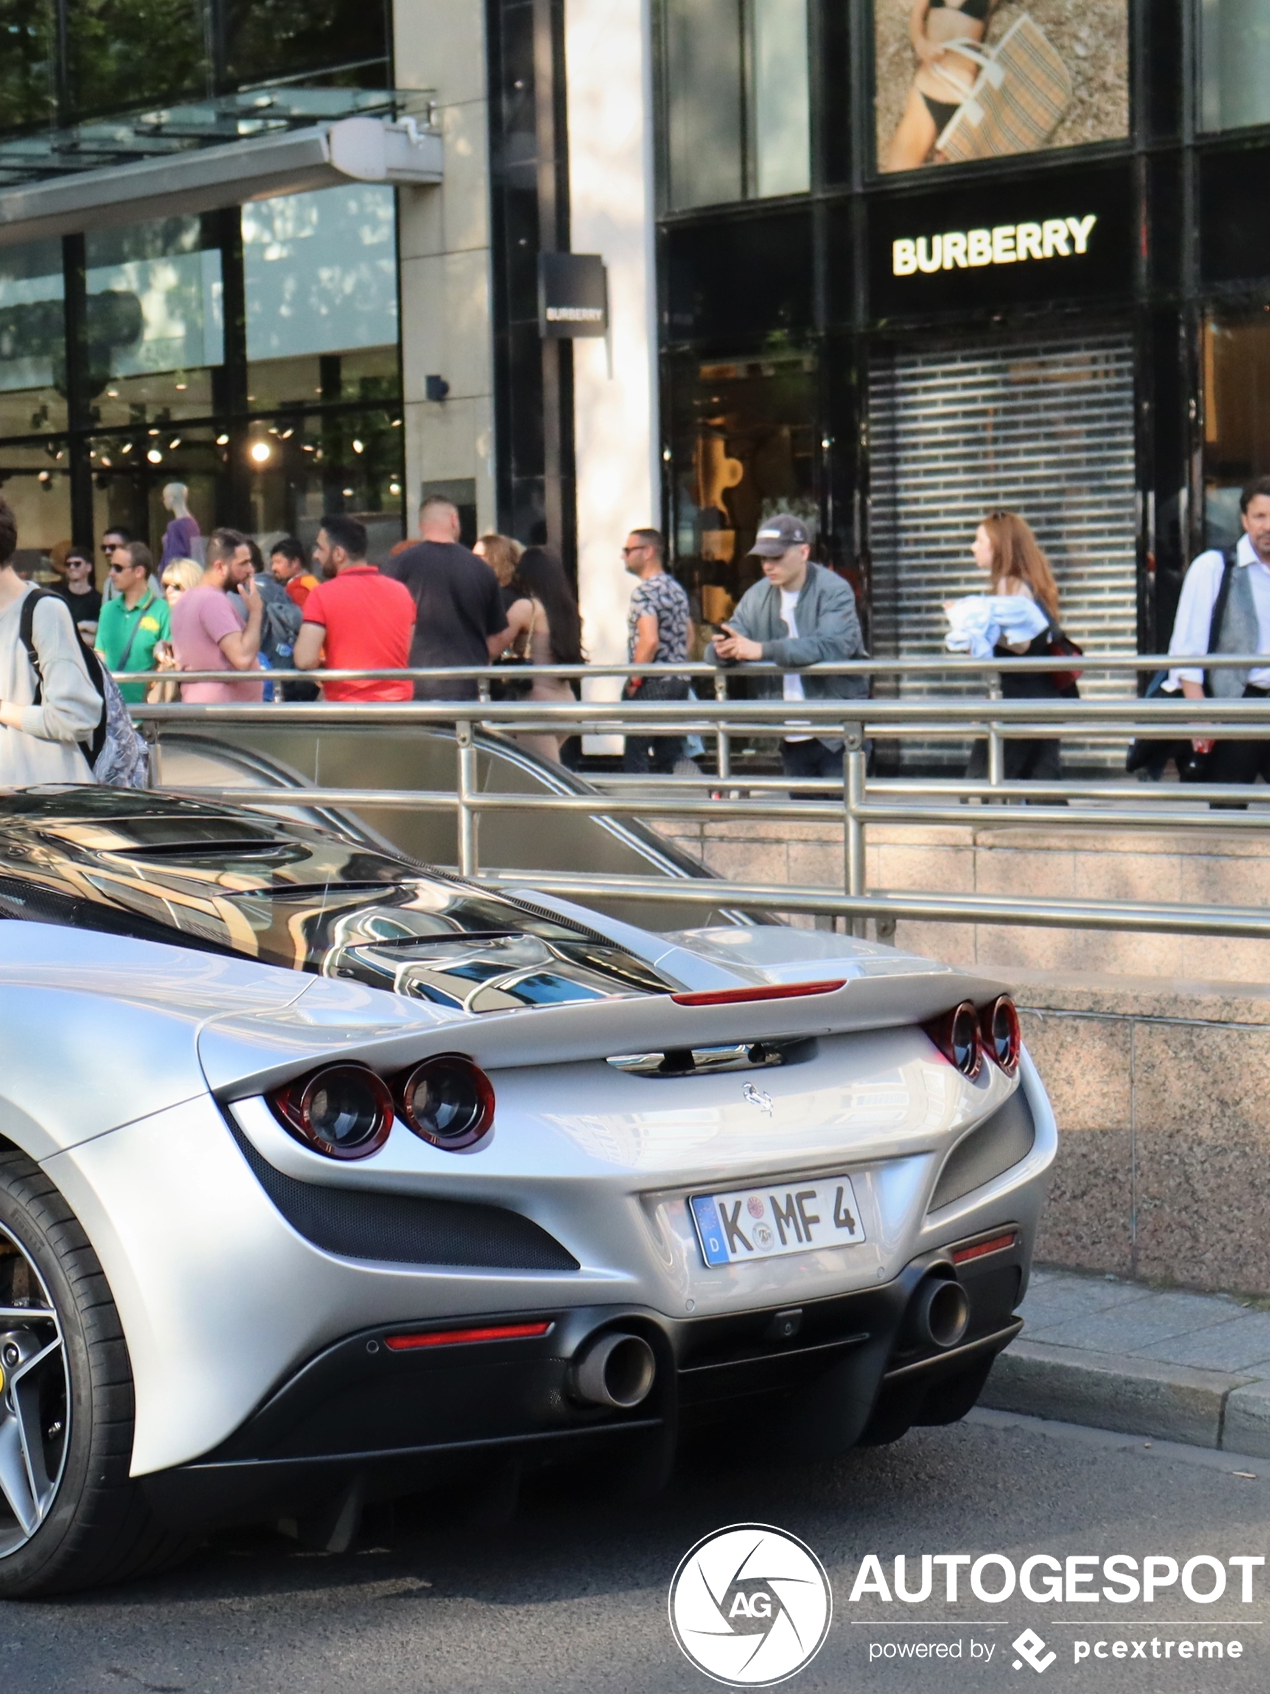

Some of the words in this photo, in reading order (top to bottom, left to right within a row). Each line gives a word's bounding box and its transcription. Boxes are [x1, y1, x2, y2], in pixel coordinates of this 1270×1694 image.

[892, 214, 1097, 276] BURBERRY
[546, 307, 604, 321] BURBERRY
[718, 1200, 754, 1254] K
[769, 1190, 820, 1246] MF
[833, 1186, 856, 1236] 4
[709, 1237, 719, 1252] D
